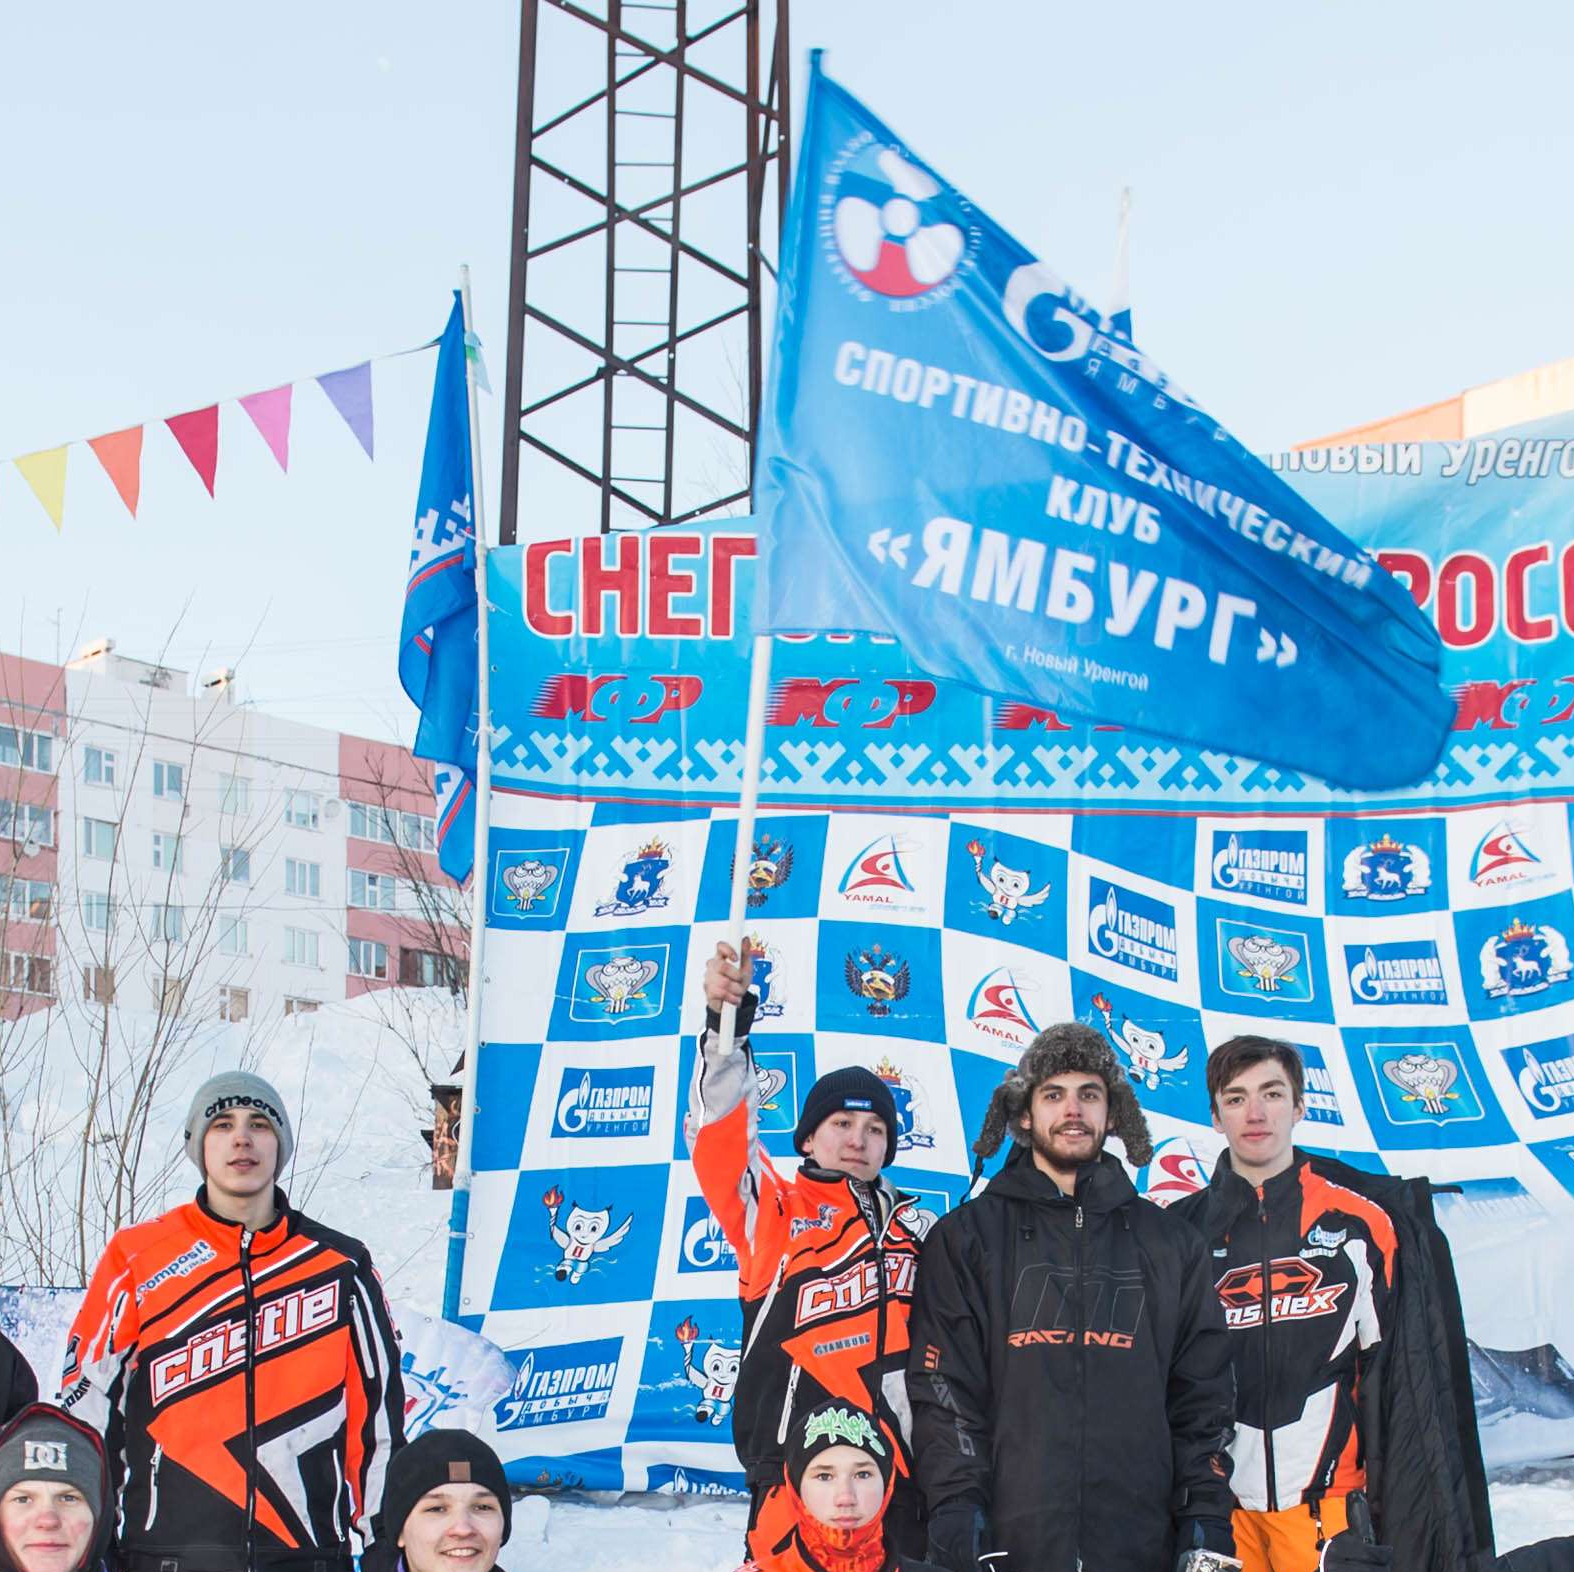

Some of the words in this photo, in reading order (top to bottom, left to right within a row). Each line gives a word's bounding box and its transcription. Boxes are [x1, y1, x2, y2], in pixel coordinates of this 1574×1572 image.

[835, 342, 1373, 591] СПОРТИВНО-ТЕХНИЧЕСКИЙ
[1046, 476, 1162, 545] КЛУБ
[525, 534, 759, 640] СНЕГ
[867, 516, 1300, 668] «ЯМБУРГ»
[1024, 646, 1079, 678] Новый
[1083, 652, 1149, 693] Уренгой
[1239, 848, 1305, 875] ГАЗПРОМ
[1474, 872, 1526, 888] YAMAL
[844, 894, 894, 904] YAMAL
[1117, 909, 1176, 952] ГАЗПРОМ
[1378, 958, 1442, 980] ГАЗПРОМ
[972, 1021, 1025, 1044] YAMAL
[589, 1086, 651, 1109] ГАЗПРОМ
[795, 1252, 915, 1329] castl
[1007, 1328, 1135, 1350] RACING
[527, 1361, 617, 1399] ГАЗПРОМ
[517, 1404, 607, 1427] ЯМБУРГ
